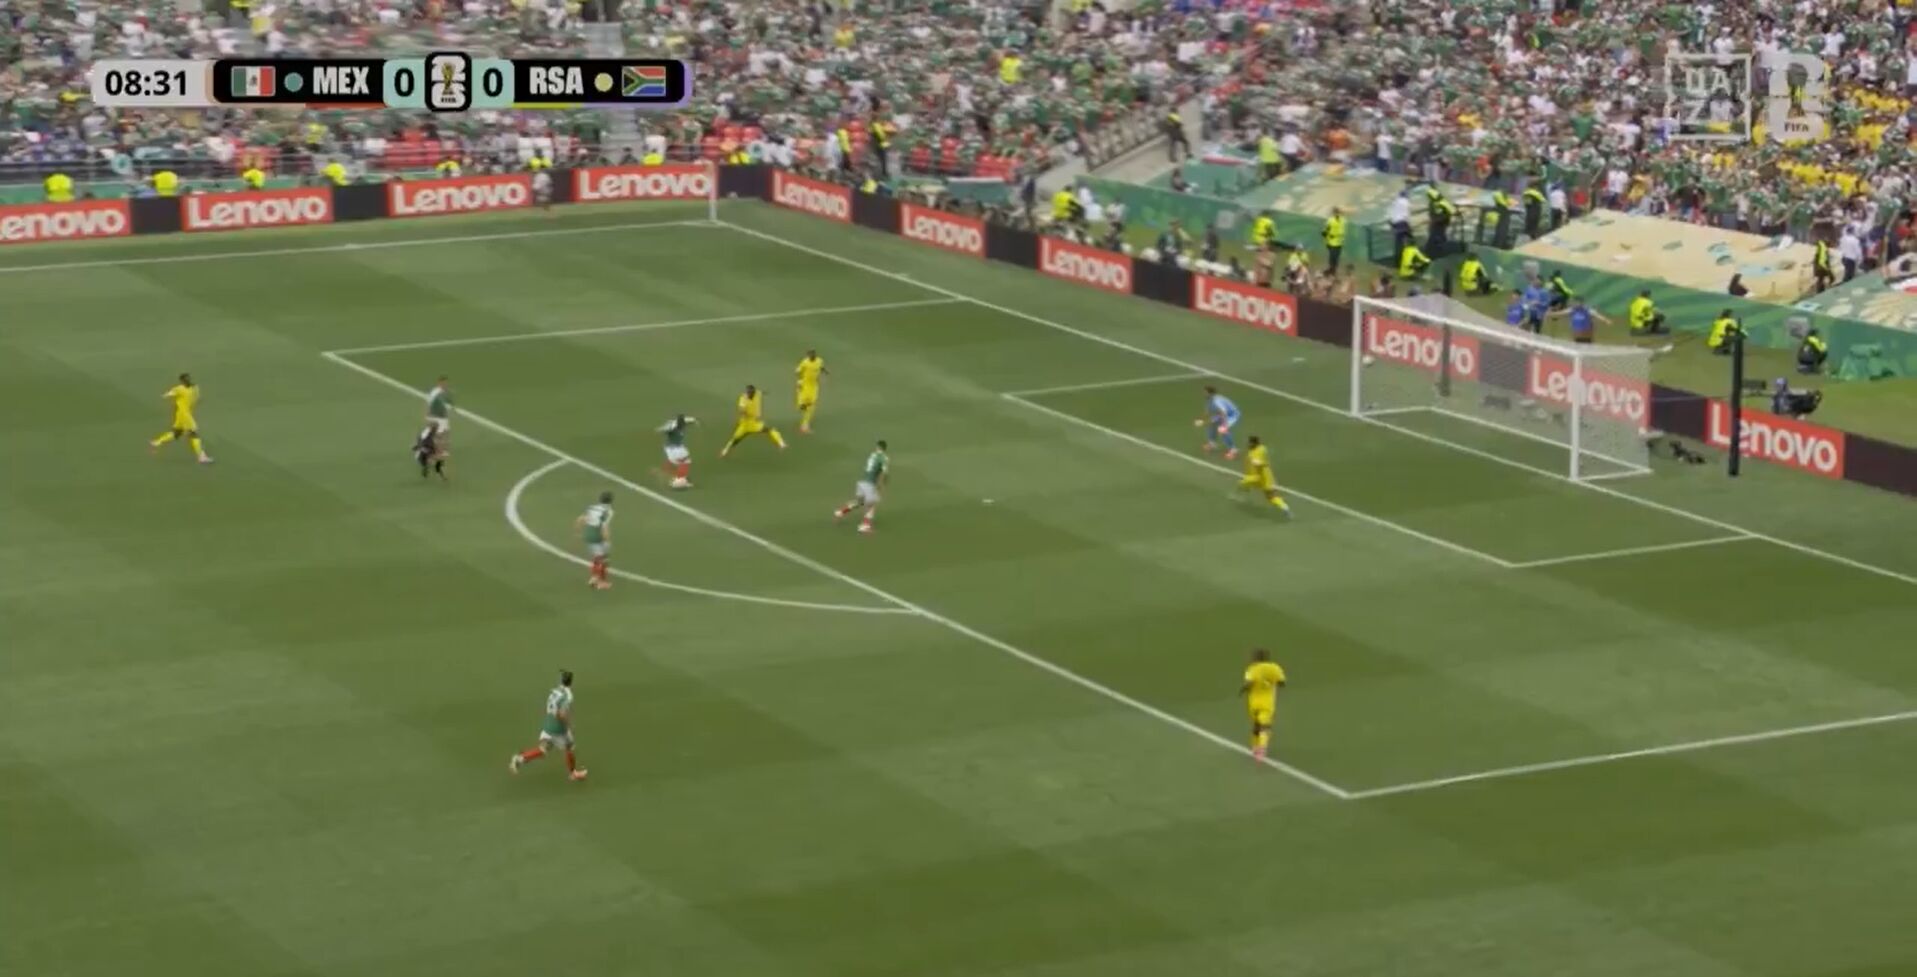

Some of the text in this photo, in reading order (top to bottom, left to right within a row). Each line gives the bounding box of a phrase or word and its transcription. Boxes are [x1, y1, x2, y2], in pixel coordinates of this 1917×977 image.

[393, 181, 528, 214] Lenovo
[578, 170, 713, 200] Lenovo
[773, 170, 849, 219] Lenovo
[0, 208, 126, 240] enovo
[188, 196, 328, 228] Lenovo
[902, 202, 983, 252] Lenovo
[1041, 237, 1130, 290] Lenovo
[1195, 275, 1293, 330] Lenovo
